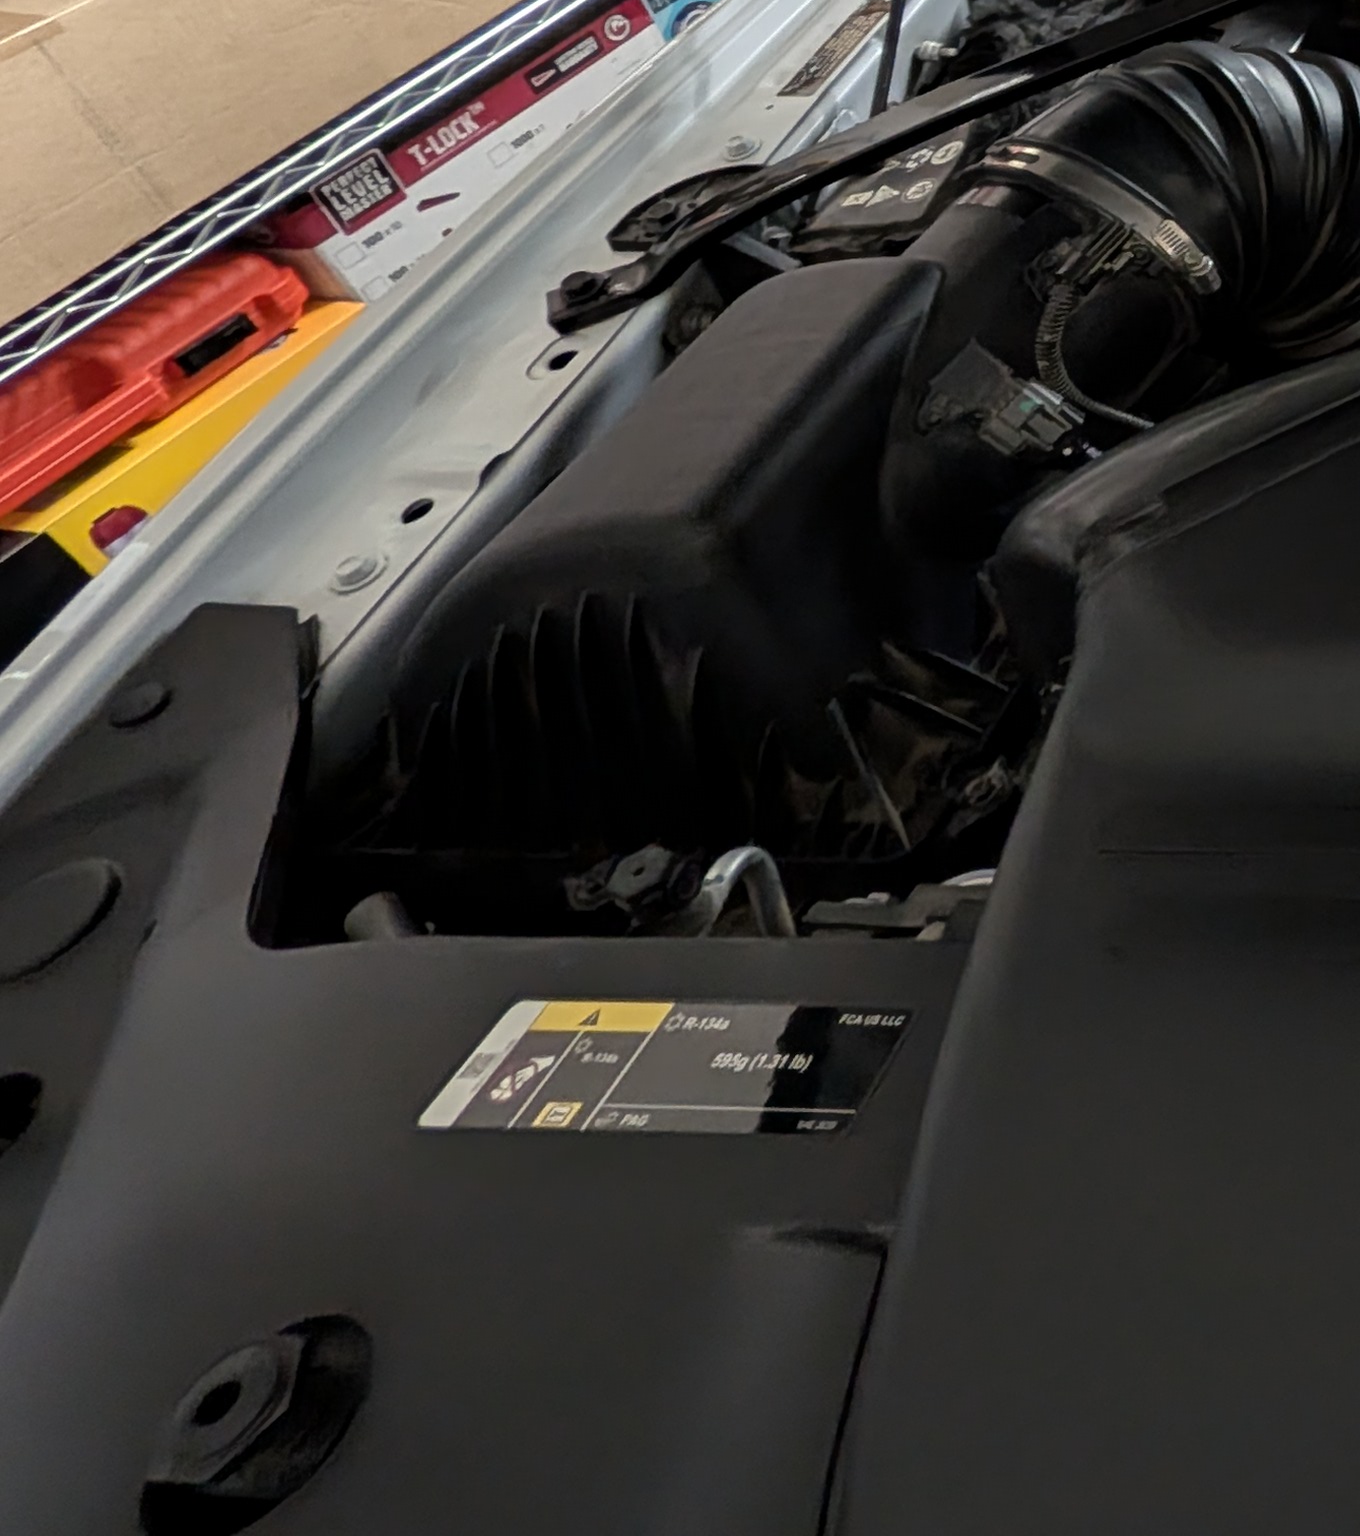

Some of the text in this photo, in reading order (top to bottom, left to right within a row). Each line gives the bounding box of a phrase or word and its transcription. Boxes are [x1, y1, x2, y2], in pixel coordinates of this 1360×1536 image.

[320, 156, 379, 198] PERFECT
[330, 169, 390, 211] LEVEL
[339, 184, 393, 222] MASTER
[838, 1014, 865, 1026] FCA
[880, 1015, 906, 1027] LLC
